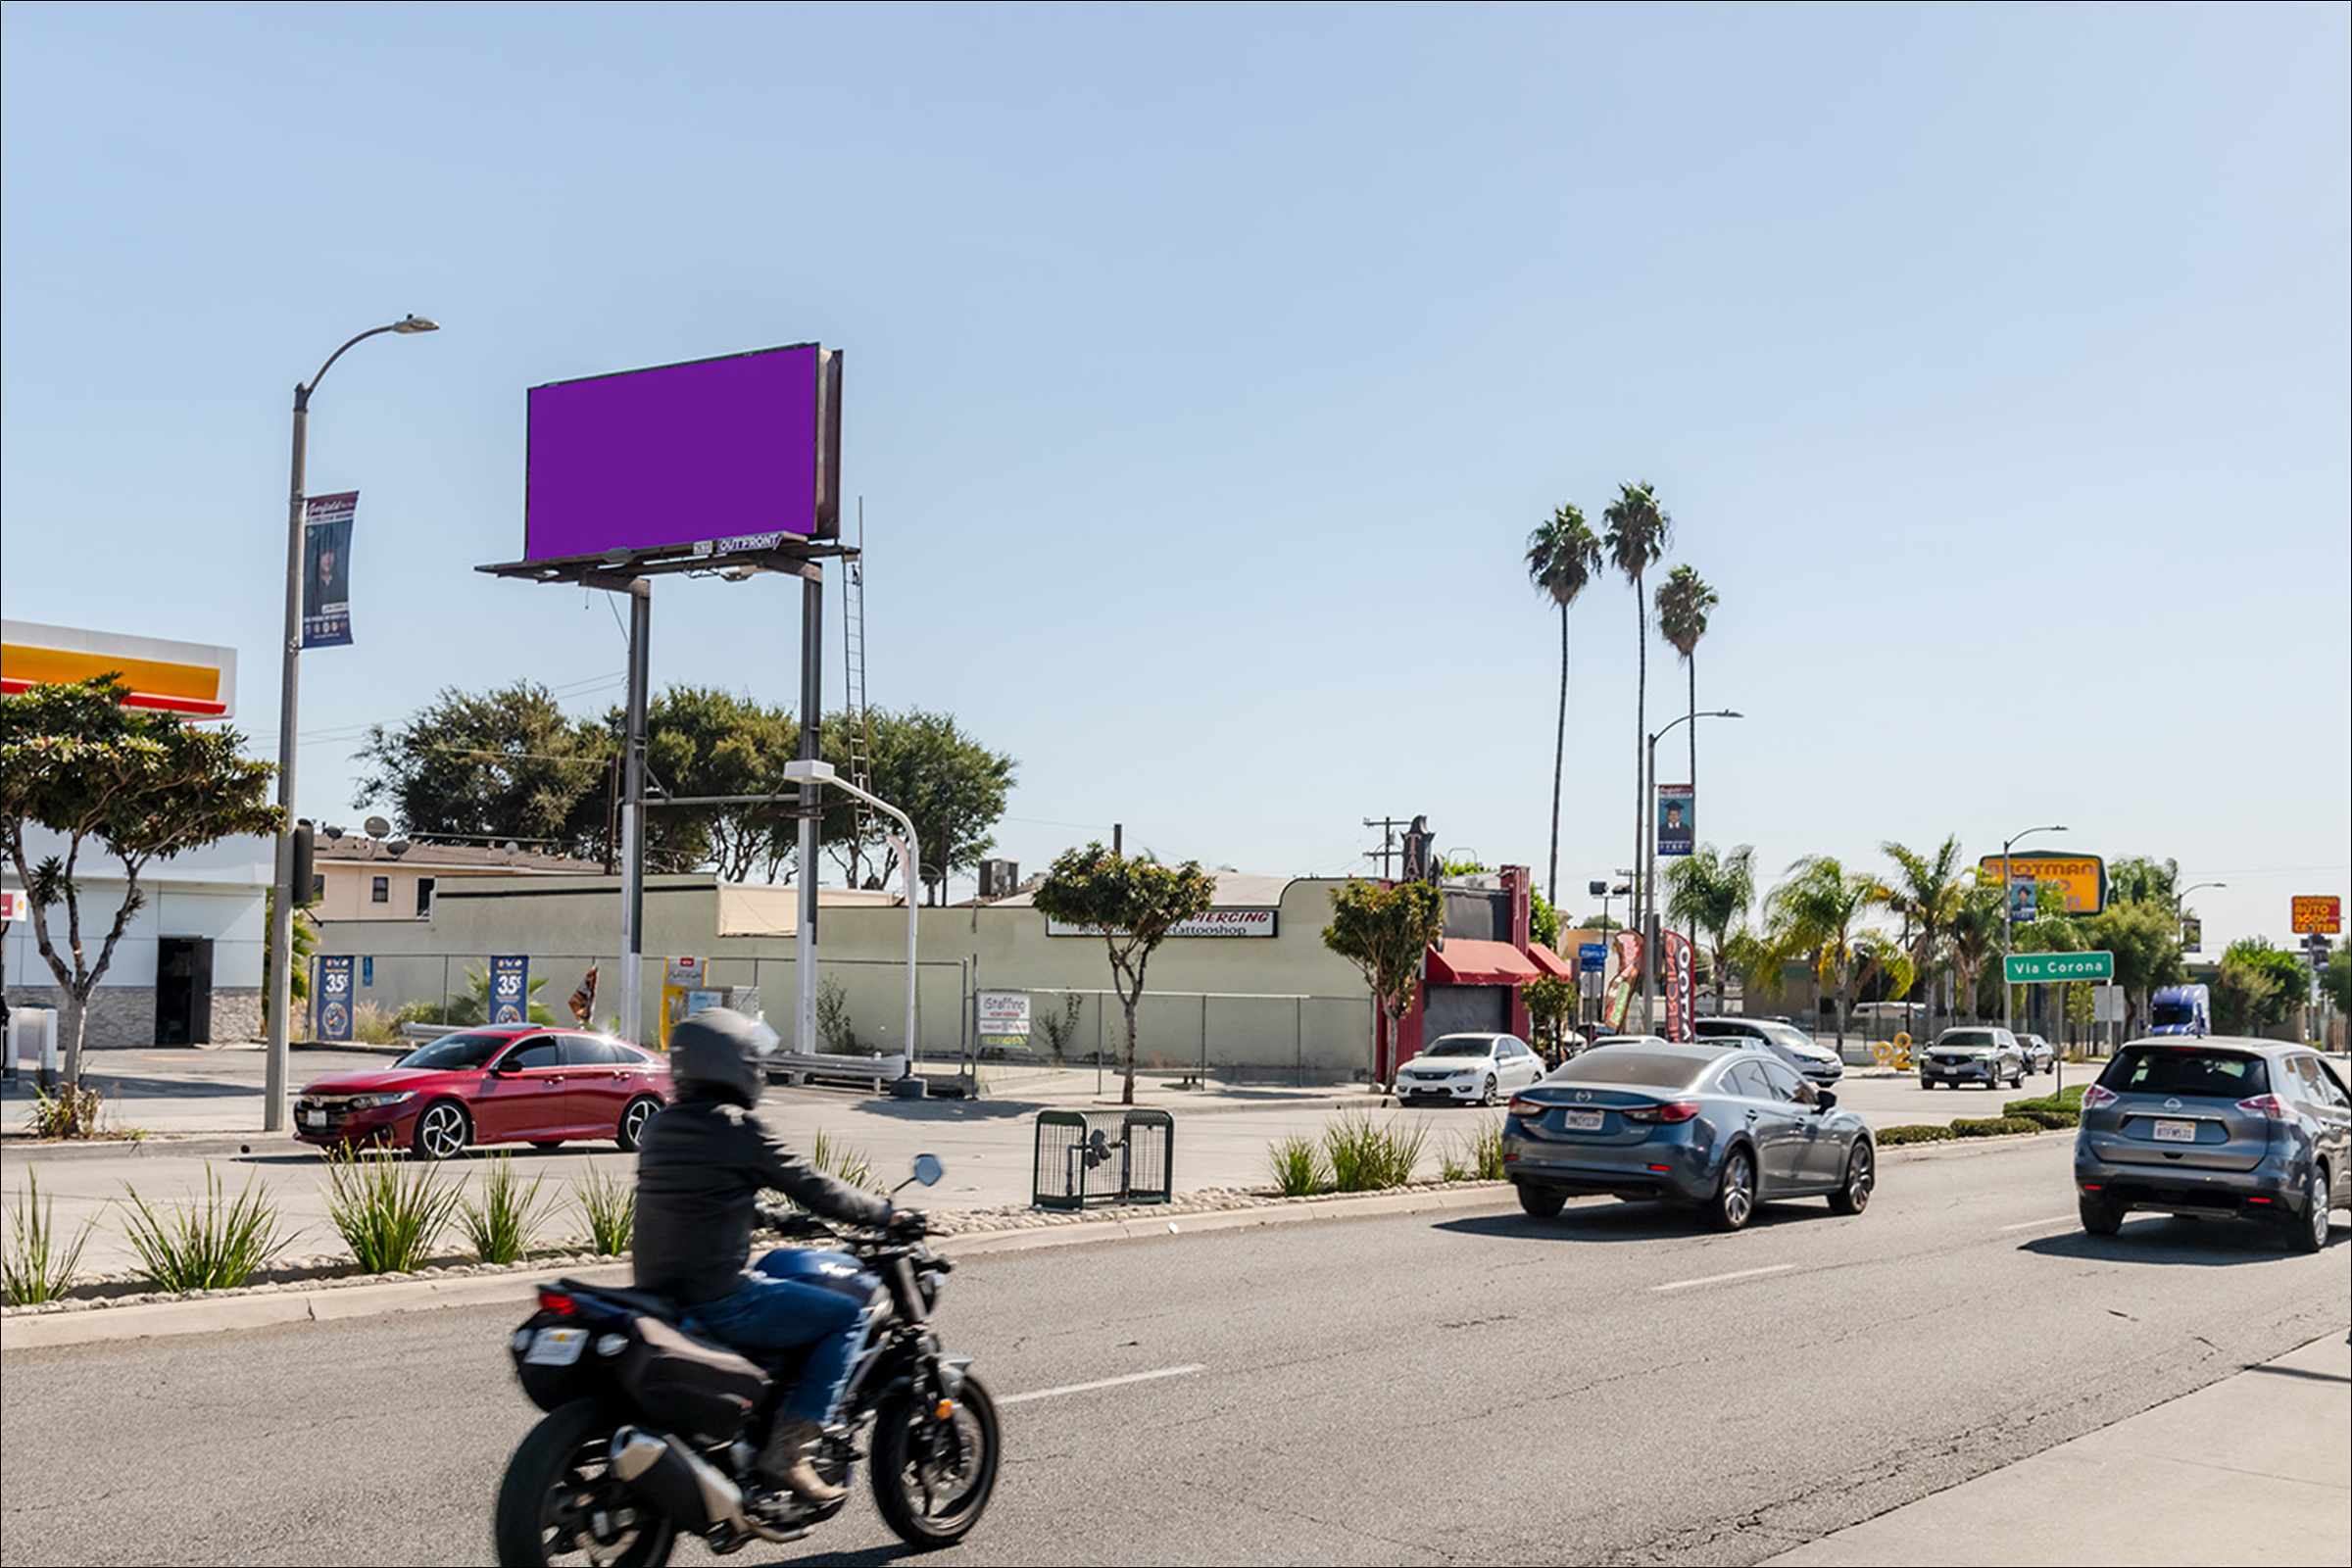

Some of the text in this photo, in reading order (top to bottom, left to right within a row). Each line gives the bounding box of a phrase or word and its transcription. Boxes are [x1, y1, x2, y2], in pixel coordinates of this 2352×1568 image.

[2295, 905, 2329, 913] AUTO
[1189, 912, 1270, 923] PIERCING
[2014, 961, 2103, 974] Via Corona
